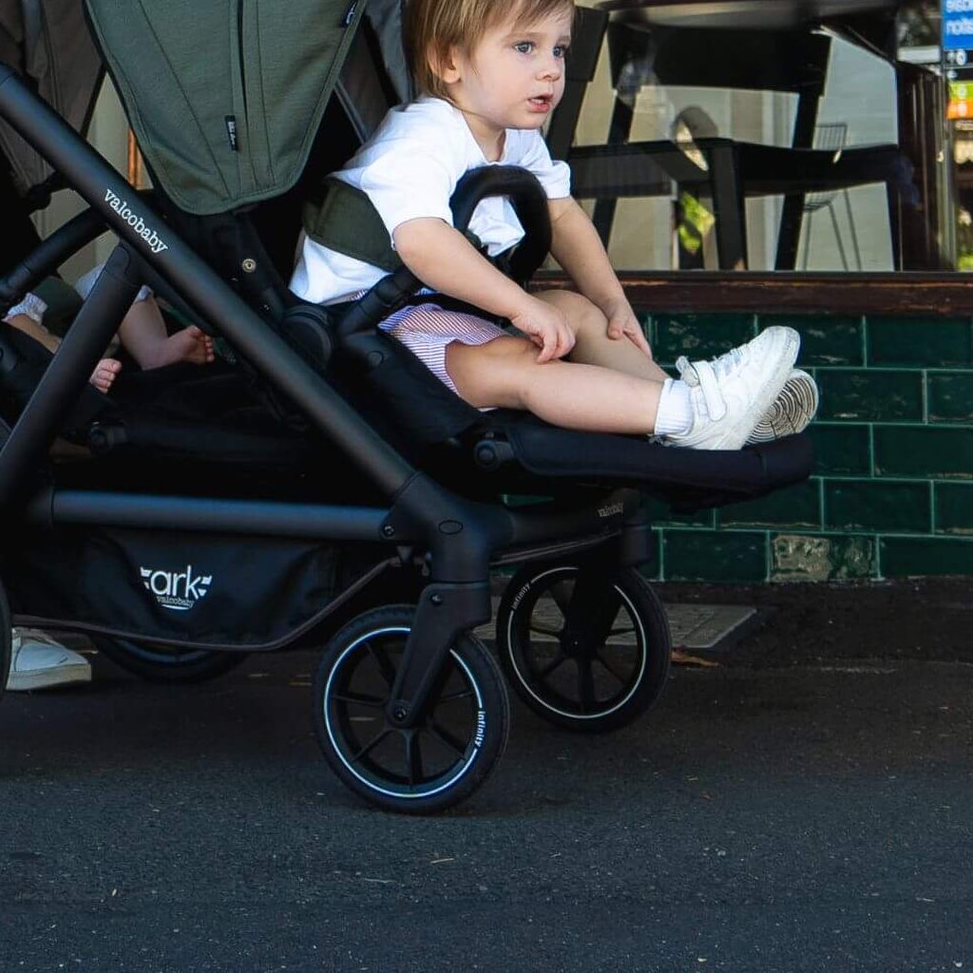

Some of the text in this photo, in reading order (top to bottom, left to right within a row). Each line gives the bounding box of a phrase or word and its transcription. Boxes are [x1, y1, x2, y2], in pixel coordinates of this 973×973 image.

[104, 188, 168, 253] valcobaby
[150, 565, 199, 599] ark
[474, 710, 487, 747] infinity
